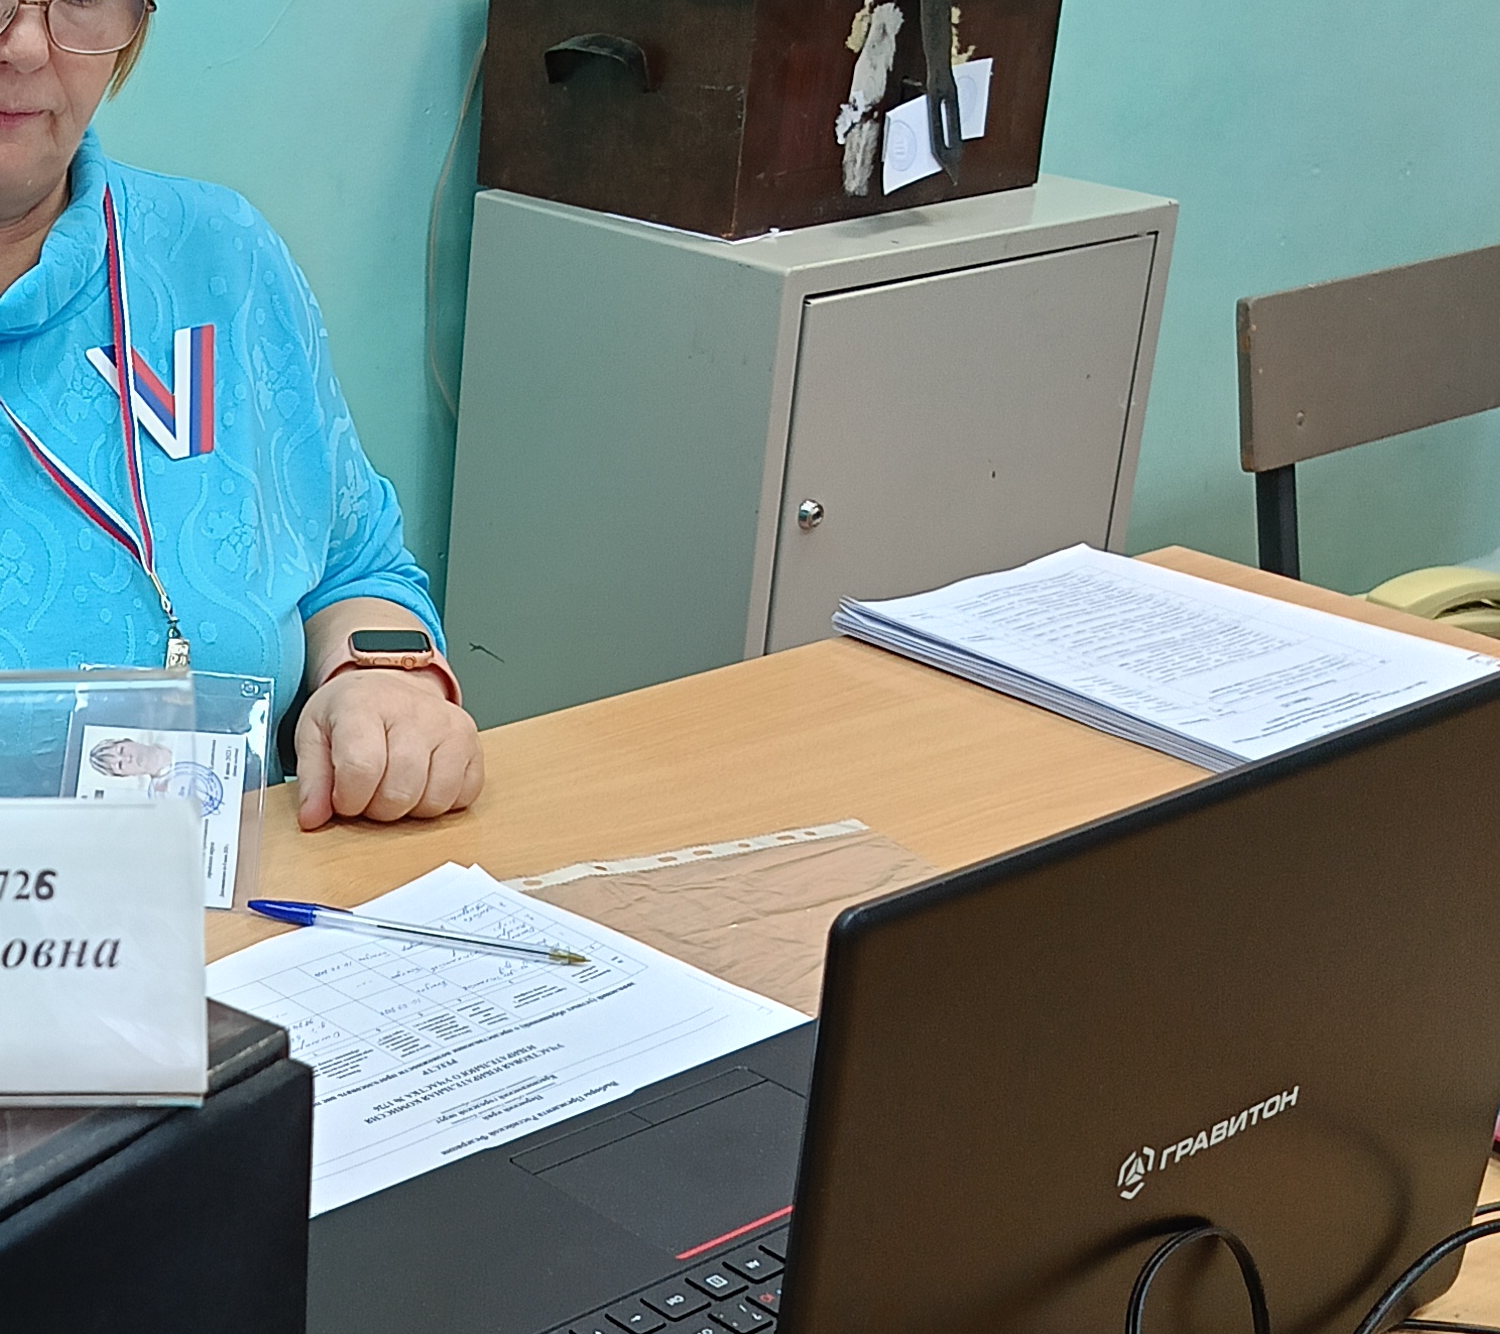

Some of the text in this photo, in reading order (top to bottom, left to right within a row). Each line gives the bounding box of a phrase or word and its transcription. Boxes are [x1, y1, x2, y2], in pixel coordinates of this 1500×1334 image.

[363, 1040, 564, 1126] УЧАСТКОВАЯ ИЗБИРАТЕЛЬНАЯ КОМИССИЯ
[401, 1042, 536, 1101] ИЗБИРАТЕЛЬНОГО УЧАСТКА
[1159, 1085, 1300, 1171] ГРАВИТОН
